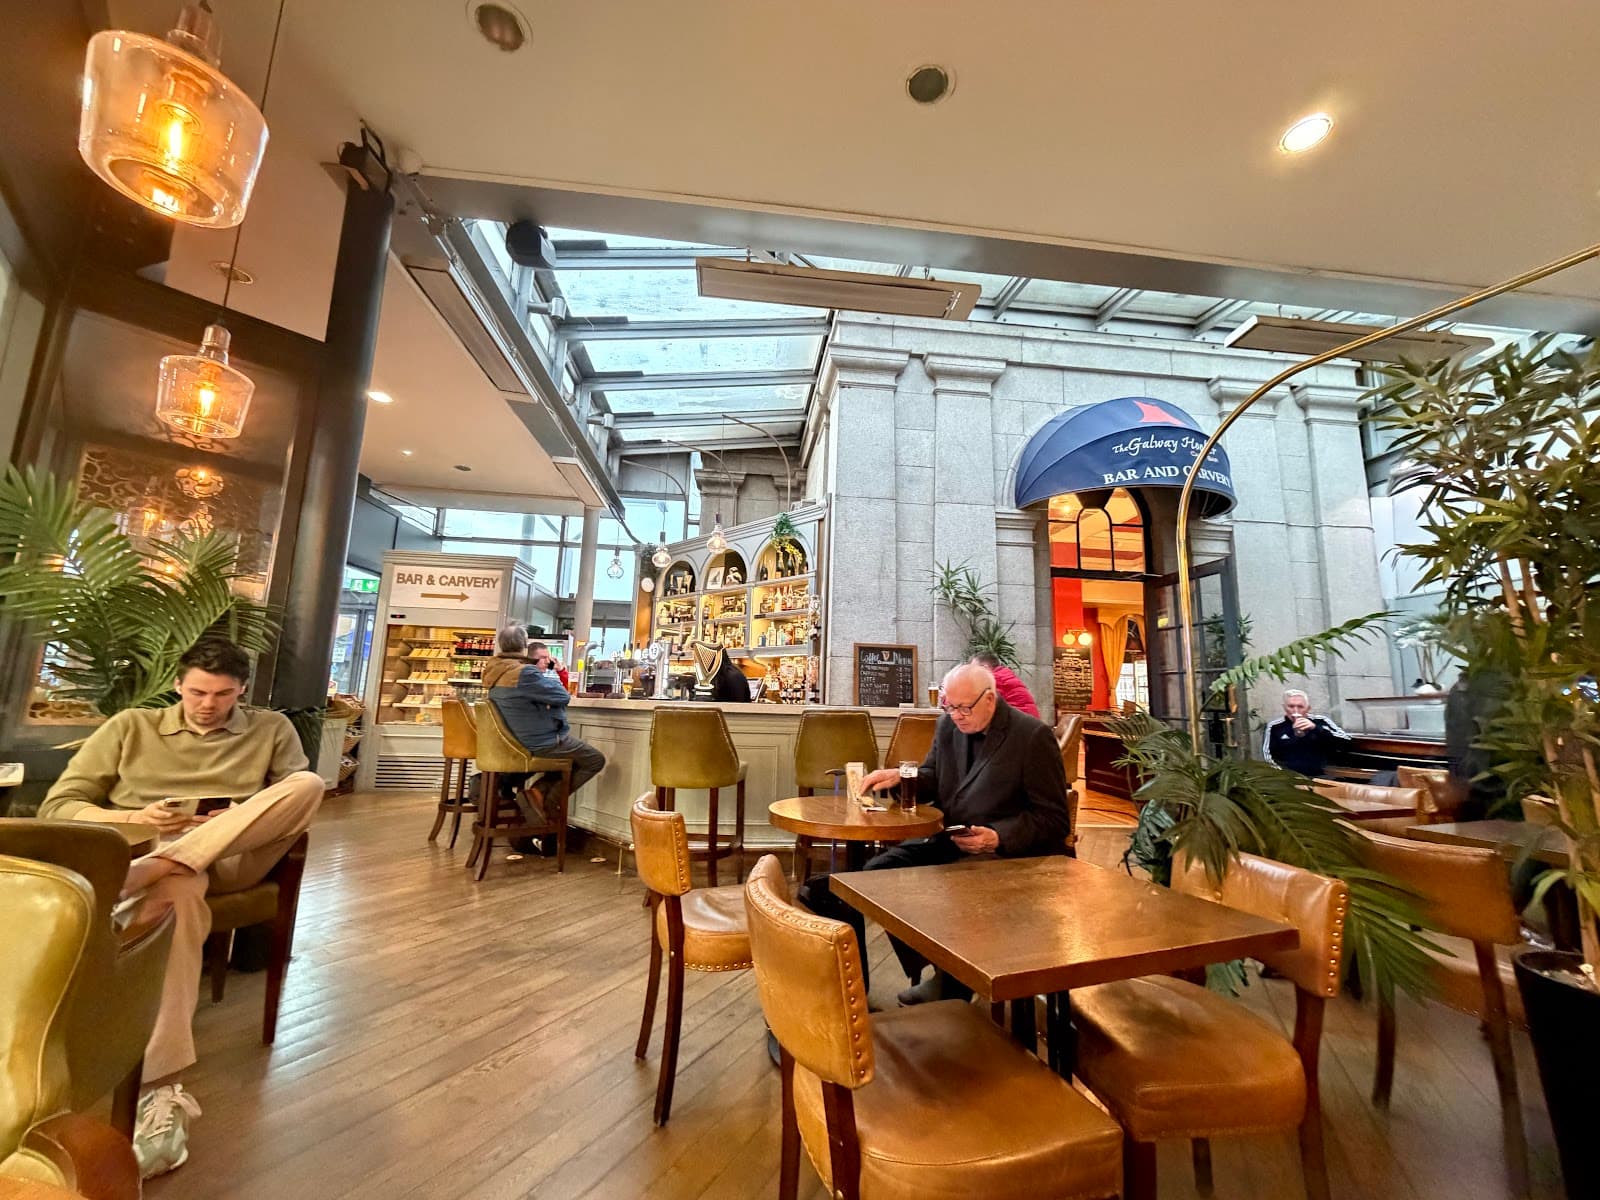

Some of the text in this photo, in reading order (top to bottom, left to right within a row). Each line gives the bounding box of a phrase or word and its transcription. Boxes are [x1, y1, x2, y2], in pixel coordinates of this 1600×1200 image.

[1111, 443, 1128, 454] The
[1128, 434, 1178, 456] Galway
[1102, 468, 1140, 485] BAR
[1144, 465, 1179, 479] AND
[396, 572, 499, 589] BAR & CARVERY
